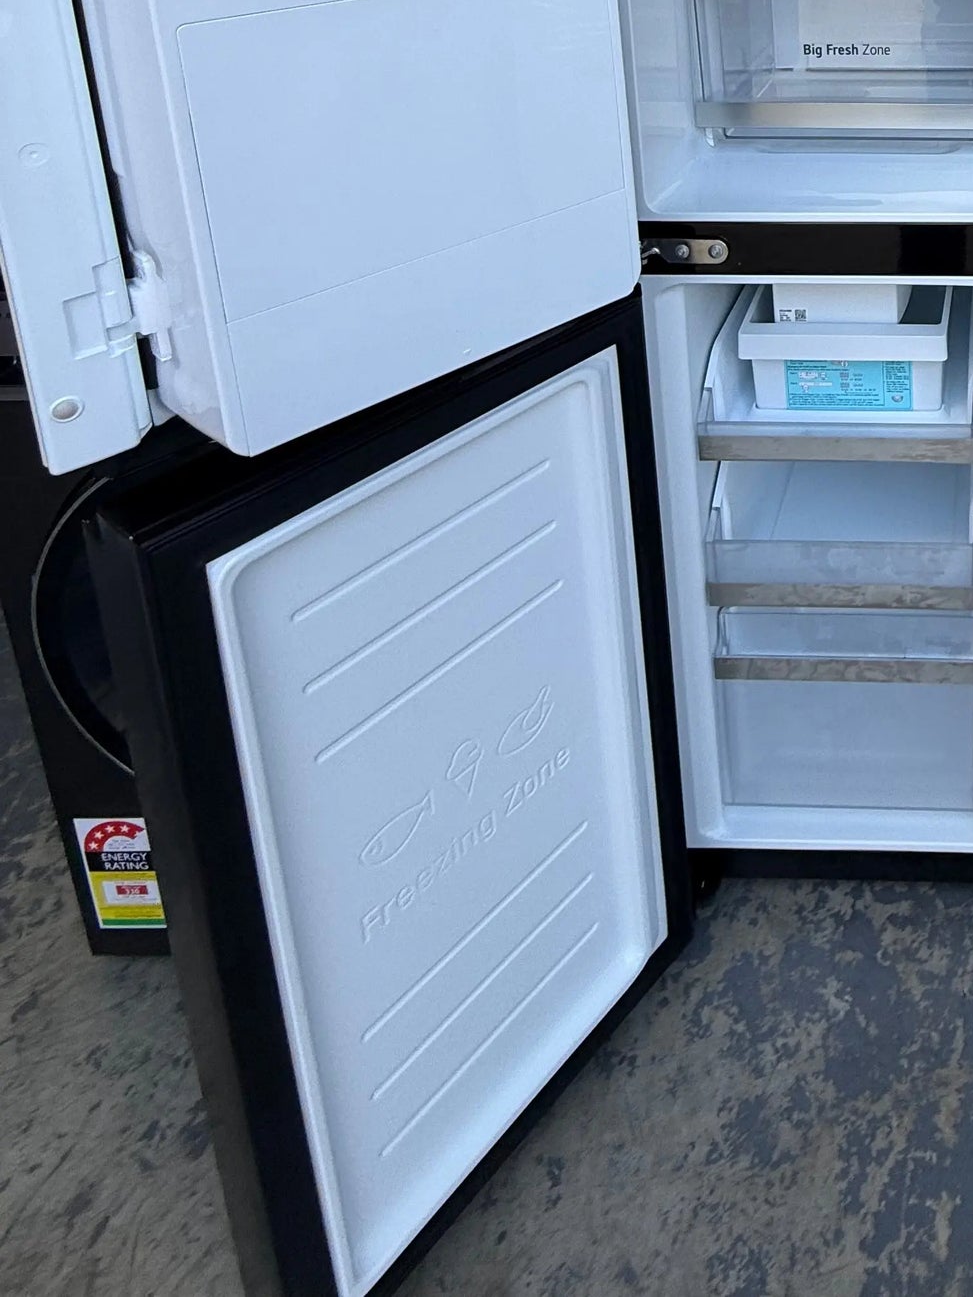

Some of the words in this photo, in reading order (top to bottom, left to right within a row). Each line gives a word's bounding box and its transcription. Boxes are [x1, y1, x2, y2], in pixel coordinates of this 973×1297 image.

[803, 43, 822, 59] Big
[826, 43, 859, 56] Fresh
[862, 43, 891, 56] Zone
[360, 808, 498, 945] Freezing
[502, 747, 570, 818] Zone
[101, 852, 147, 862] ENERGY
[104, 862, 149, 870] RATING
